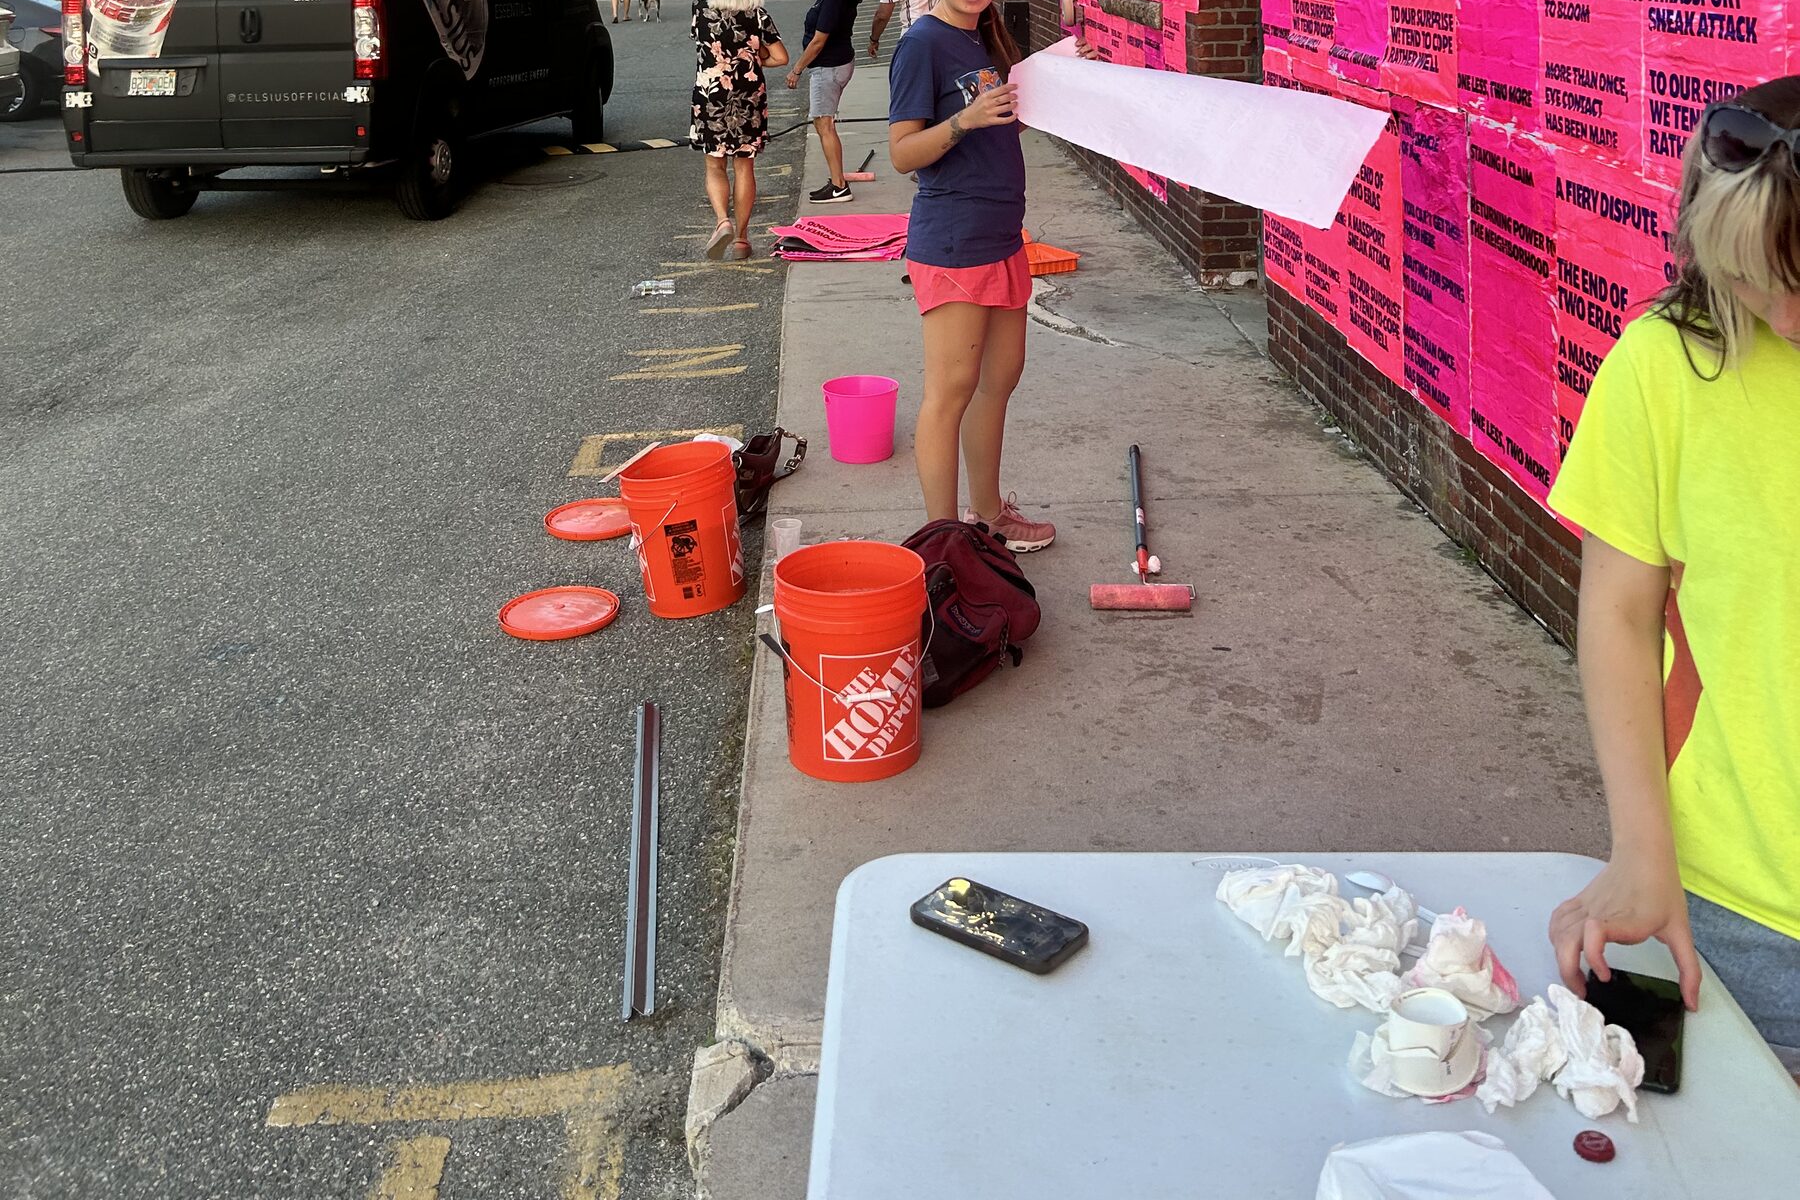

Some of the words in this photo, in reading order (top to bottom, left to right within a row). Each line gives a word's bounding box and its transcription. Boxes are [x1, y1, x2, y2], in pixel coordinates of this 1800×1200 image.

[1391, 5, 1400, 22] TO
[1401, 7, 1416, 26] OUR
[1417, 9, 1454, 32] SURPRISE
[1544, 0, 1556, 18] TO
[1557, 0, 1590, 23] BLOOM
[1648, 7, 1695, 36] SNEAK
[1697, 12, 1758, 44] ATTACK
[1401, 28, 1421, 47] TEND
[1421, 31, 1431, 50] TO
[1433, 33, 1453, 54] COPE
[1420, 52, 1439, 73] WELL
[226, 91, 346, 103] @CELSIUSOFFICIAL
[1457, 73, 1471, 91] ONE
[1490, 81, 1507, 101] TWO
[1508, 86, 1532, 108] MORE
[1545, 61, 1571, 83] MORE
[1572, 66, 1598, 90] THAN
[1599, 73, 1629, 103] ONCE,
[1649, 69, 1667, 96] TO
[1670, 73, 1702, 103] OUR
[1545, 86, 1561, 107] EYE
[1562, 90, 1603, 118] CONTACT
[1649, 99, 1671, 127] WE
[1672, 104, 1704, 132] TEN
[1545, 111, 1563, 134] HAS
[1564, 117, 1588, 140] BEEN
[1589, 125, 1618, 149] MADE
[1649, 129, 1688, 160] RATH
[1360, 164, 1374, 185] END
[1375, 171, 1384, 191] OF
[1470, 143, 1501, 173] STAKING
[1502, 157, 1508, 176] A
[1508, 160, 1535, 188] CLAIM
[1363, 189, 1381, 211] ERAS
[1556, 176, 1564, 201] A
[1566, 179, 1599, 213] FIERY
[1600, 192, 1658, 237] DISPUTE
[1353, 215, 1386, 249] MASSPORT
[1470, 196, 1512, 234] RETURNING
[1513, 219, 1545, 252] POWER
[1546, 235, 1556, 258] TO
[1348, 231, 1368, 257] SNEAK
[1368, 241, 1391, 273] ATTACK
[1470, 219, 1484, 241] THE
[1485, 227, 1549, 279] NEIGHBORHOOD
[1356, 277, 1370, 299] OUR
[1370, 286, 1402, 322] SURPRISE
[1557, 257, 1580, 290] THE
[1582, 268, 1608, 302] END
[1610, 282, 1628, 312] OF
[1350, 307, 1372, 338] RATHER
[1373, 325, 1389, 353] WELL
[1557, 285, 1585, 321] TWO
[1588, 301, 1621, 340] ERAS
[1559, 335, 1567, 359] A
[1568, 340, 1604, 376] MASS
[1559, 414, 1573, 443] TO
[1471, 407, 1486, 433] ONE
[1486, 420, 1505, 455] LESS,
[1505, 436, 1524, 465] TWO
[1524, 452, 1550, 489] MORE
[824, 645, 919, 761] HOME
[832, 666, 881, 710] THE
[865, 678, 919, 758] DEPOT
